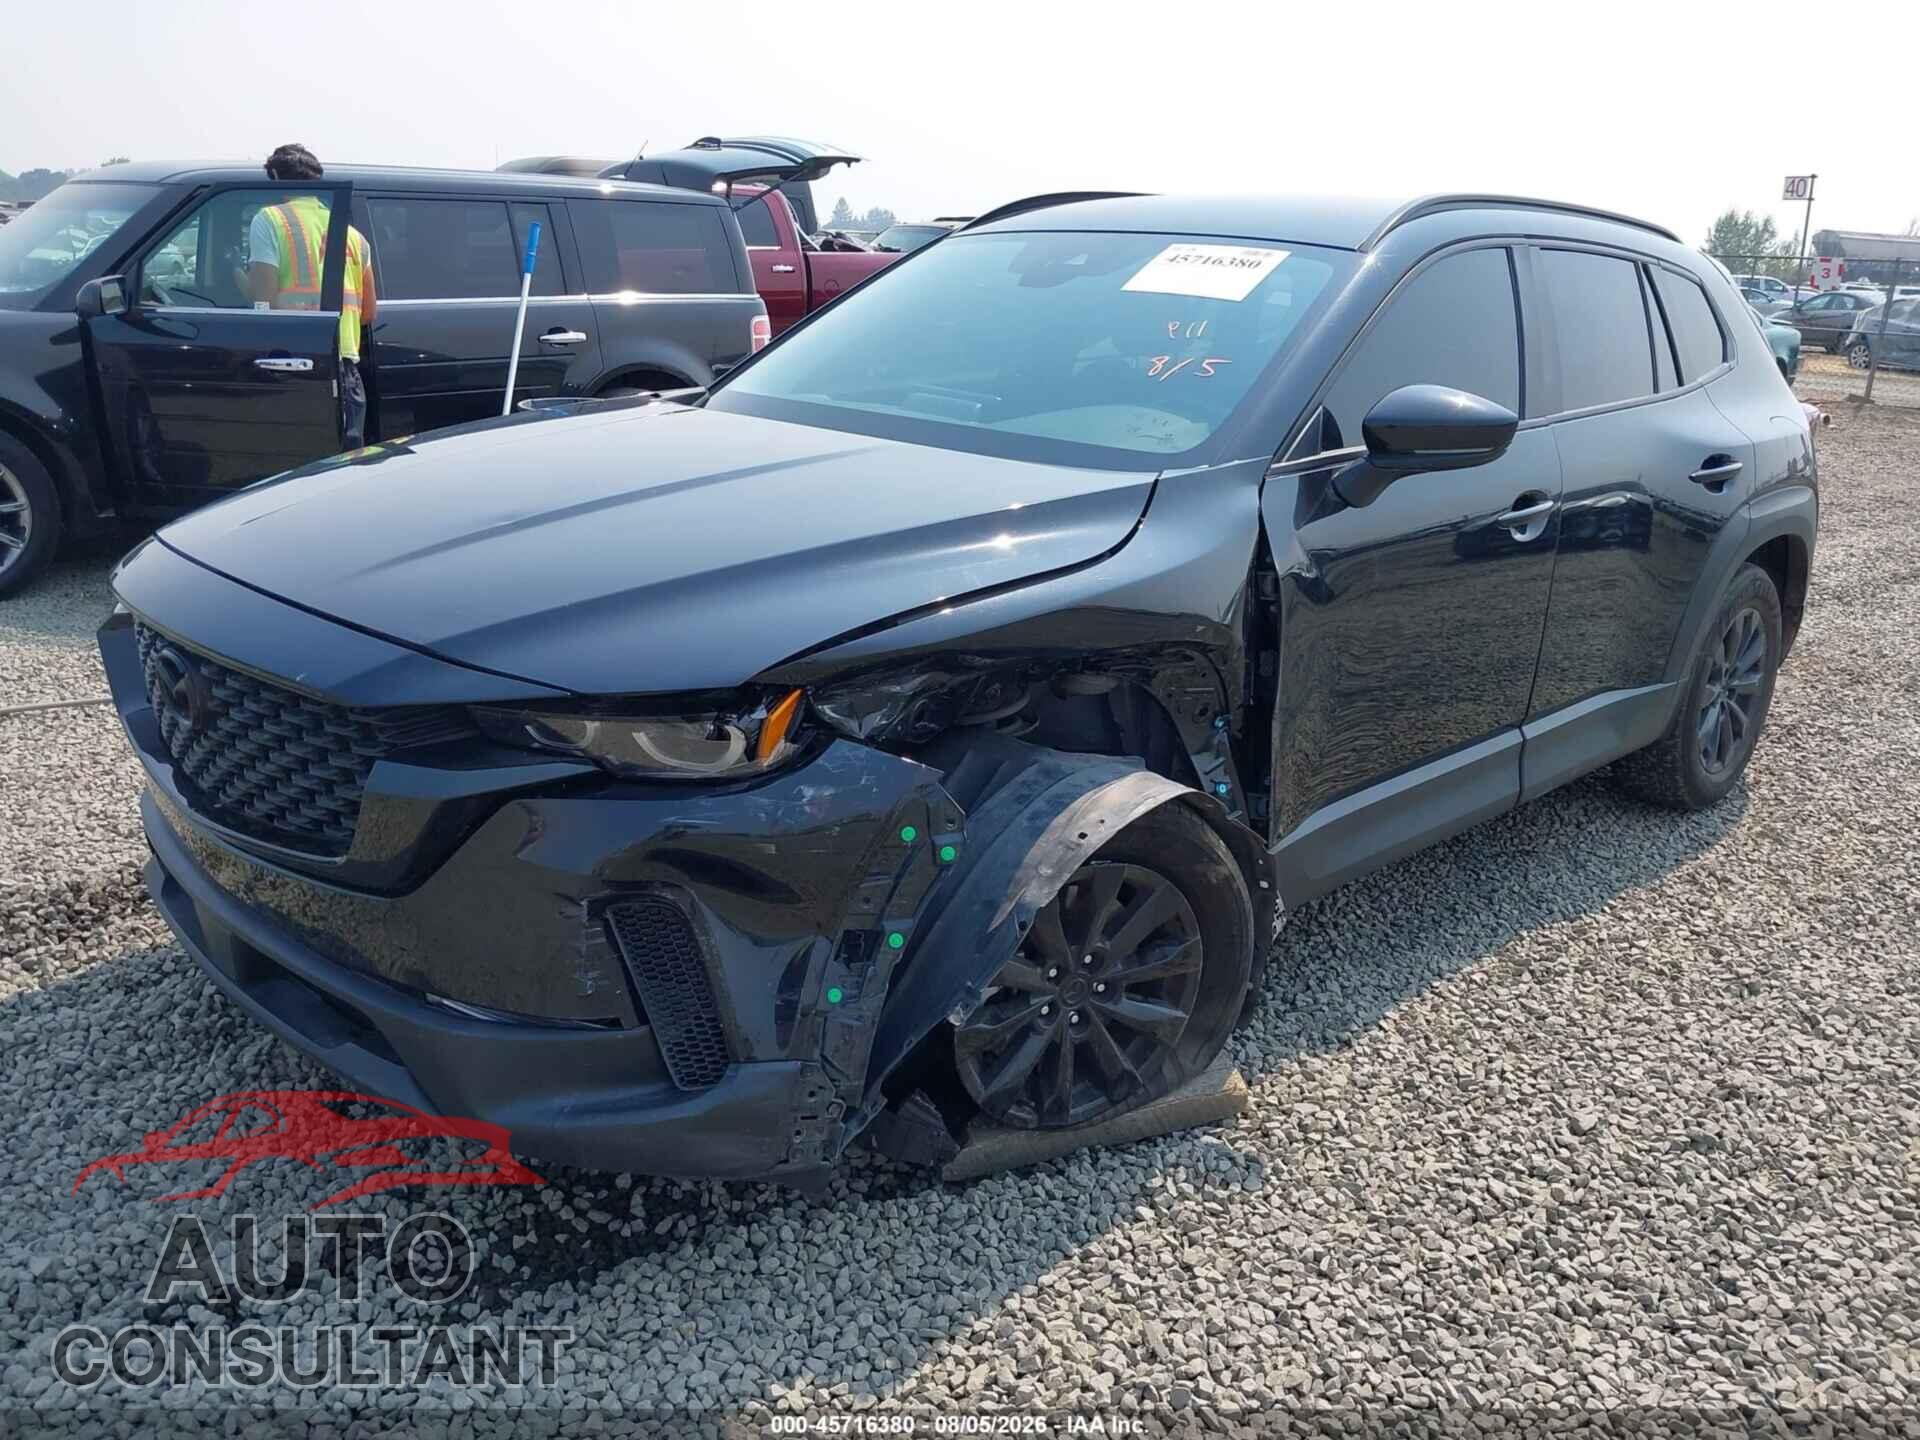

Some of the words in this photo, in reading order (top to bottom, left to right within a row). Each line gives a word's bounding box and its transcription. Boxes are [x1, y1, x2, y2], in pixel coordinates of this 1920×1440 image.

[1784, 178, 1807, 198] 40
[1168, 253, 1262, 269] 45716380
[1821, 267, 1831, 279] 3
